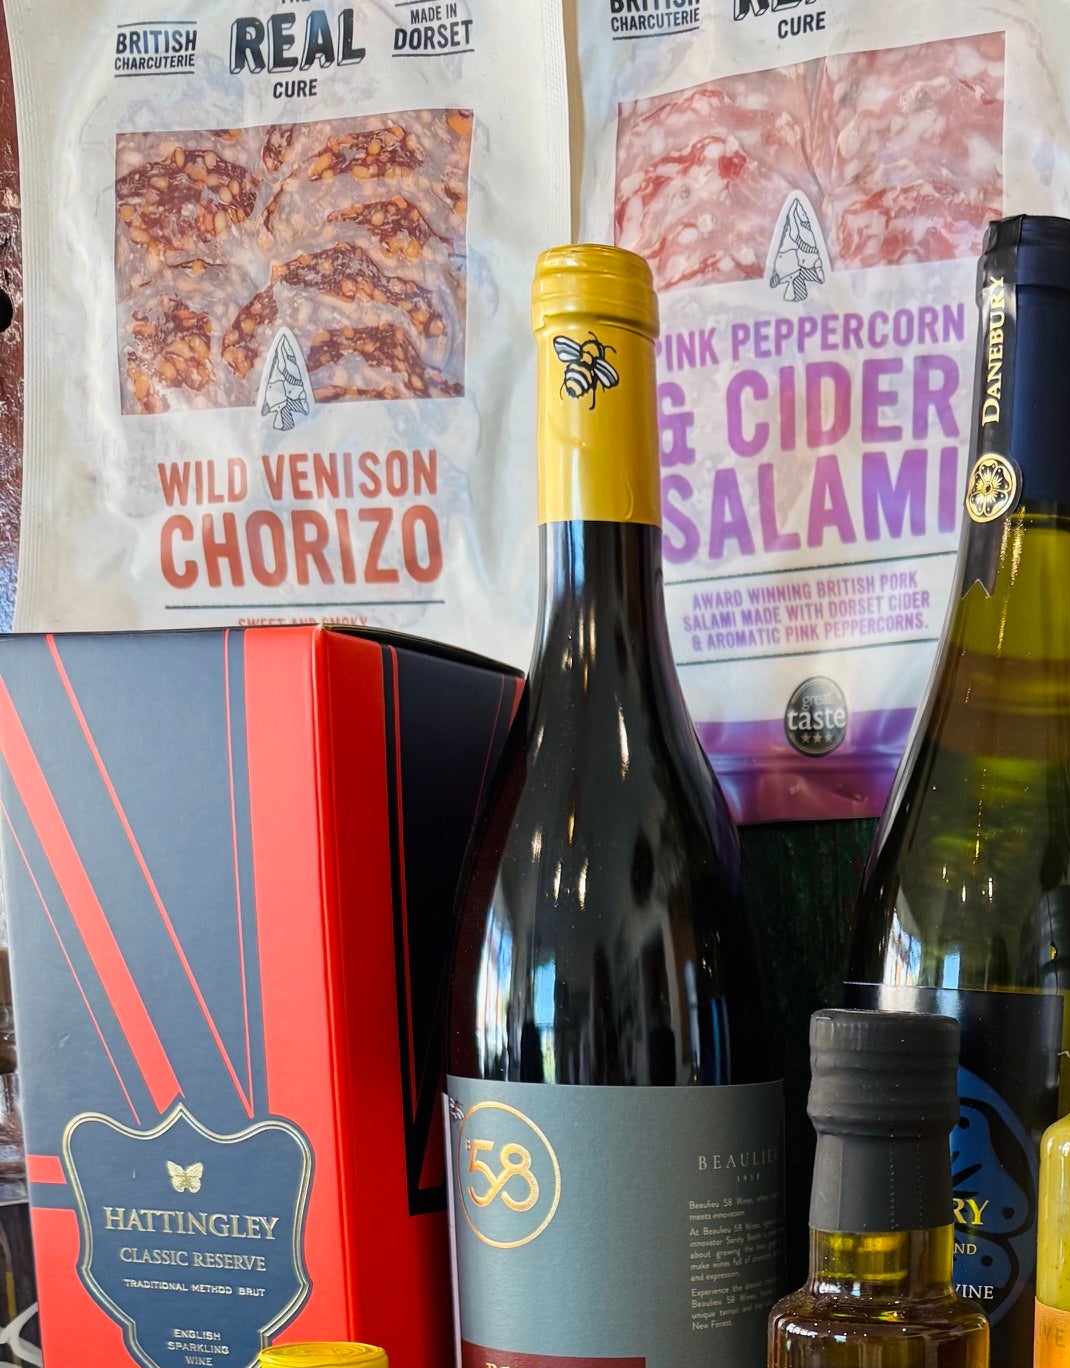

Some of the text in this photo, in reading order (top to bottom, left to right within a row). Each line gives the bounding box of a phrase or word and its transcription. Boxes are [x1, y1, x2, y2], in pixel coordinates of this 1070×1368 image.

[410, 8, 441, 25] MADE
[611, 8, 700, 32] CHARCUTERIE
[777, 11, 826, 39] CURE
[115, 29, 197, 54] BRITISH
[229, 8, 366, 75] REAL
[393, 19, 474, 50] DORSET
[114, 53, 196, 70] CHARCUTERIE
[272, 78, 318, 99] CURE
[731, 303, 966, 362] PEPPERCORN
[982, 276, 1005, 427] DANEBURY
[658, 354, 961, 468] & CIDER
[158, 449, 438, 507] WILD VENISON
[662, 446, 960, 565] SALAMI
[160, 504, 443, 589] CHORIZO
[692, 571, 918, 611] AWARD WINNING BRITISH PORK
[787, 706, 847, 731] taste
[104, 1206, 279, 1241] HATTINGLEY
[120, 1246, 267, 1273] CLASSIC RESERVE
[124, 1278, 233, 1296] TRADITIONAL METHOD
[167, 1341, 230, 1355] SPARKLING
[174, 1328, 221, 1342] ENGLISH
[185, 1355, 213, 1368] WINE
